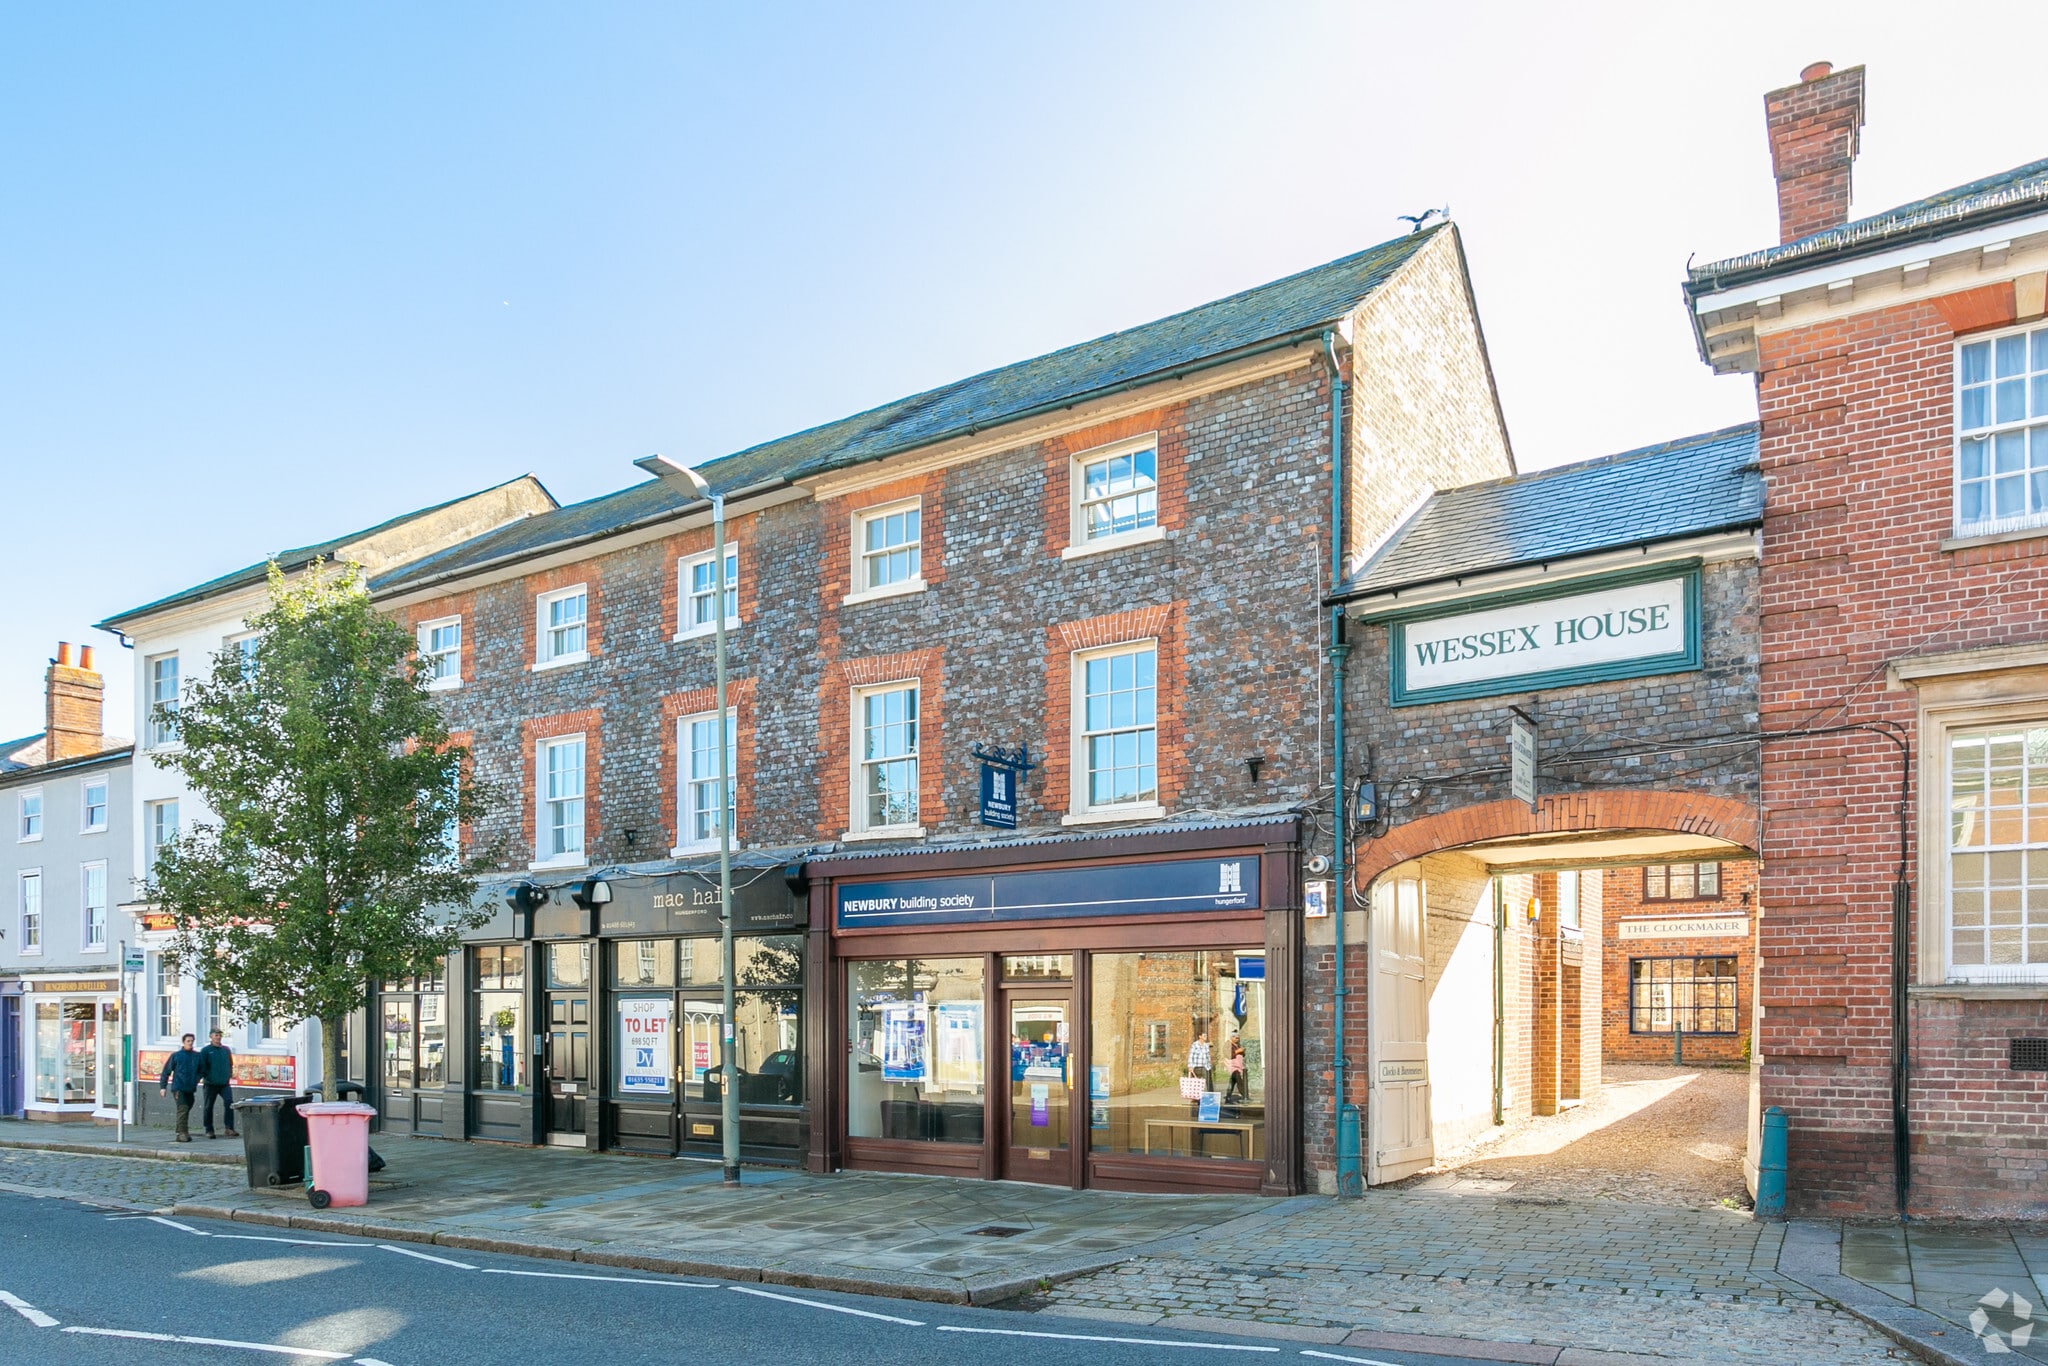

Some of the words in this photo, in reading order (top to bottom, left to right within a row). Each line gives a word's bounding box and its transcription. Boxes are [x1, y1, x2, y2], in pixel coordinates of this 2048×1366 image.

[1414, 625, 1541, 667] WESSEX
[1554, 604, 1670, 646] HOUSE
[987, 801, 1011, 811] NEWBURY
[984, 808, 1000, 820] building
[1001, 813, 1015, 822] society
[653, 893, 684, 908] mac
[692, 888, 735, 905] hai
[844, 897, 898, 912] NEWBURY
[900, 896, 937, 910] building
[939, 894, 975, 907] society
[1214, 897, 1246, 906] hungerford
[1626, 925, 1650, 933] THE
[1653, 921, 1740, 932] CLOCKMAKER
[633, 1002, 655, 1012] SHOP
[625, 1018, 641, 1033] TO
[644, 1018, 667, 1033] LET
